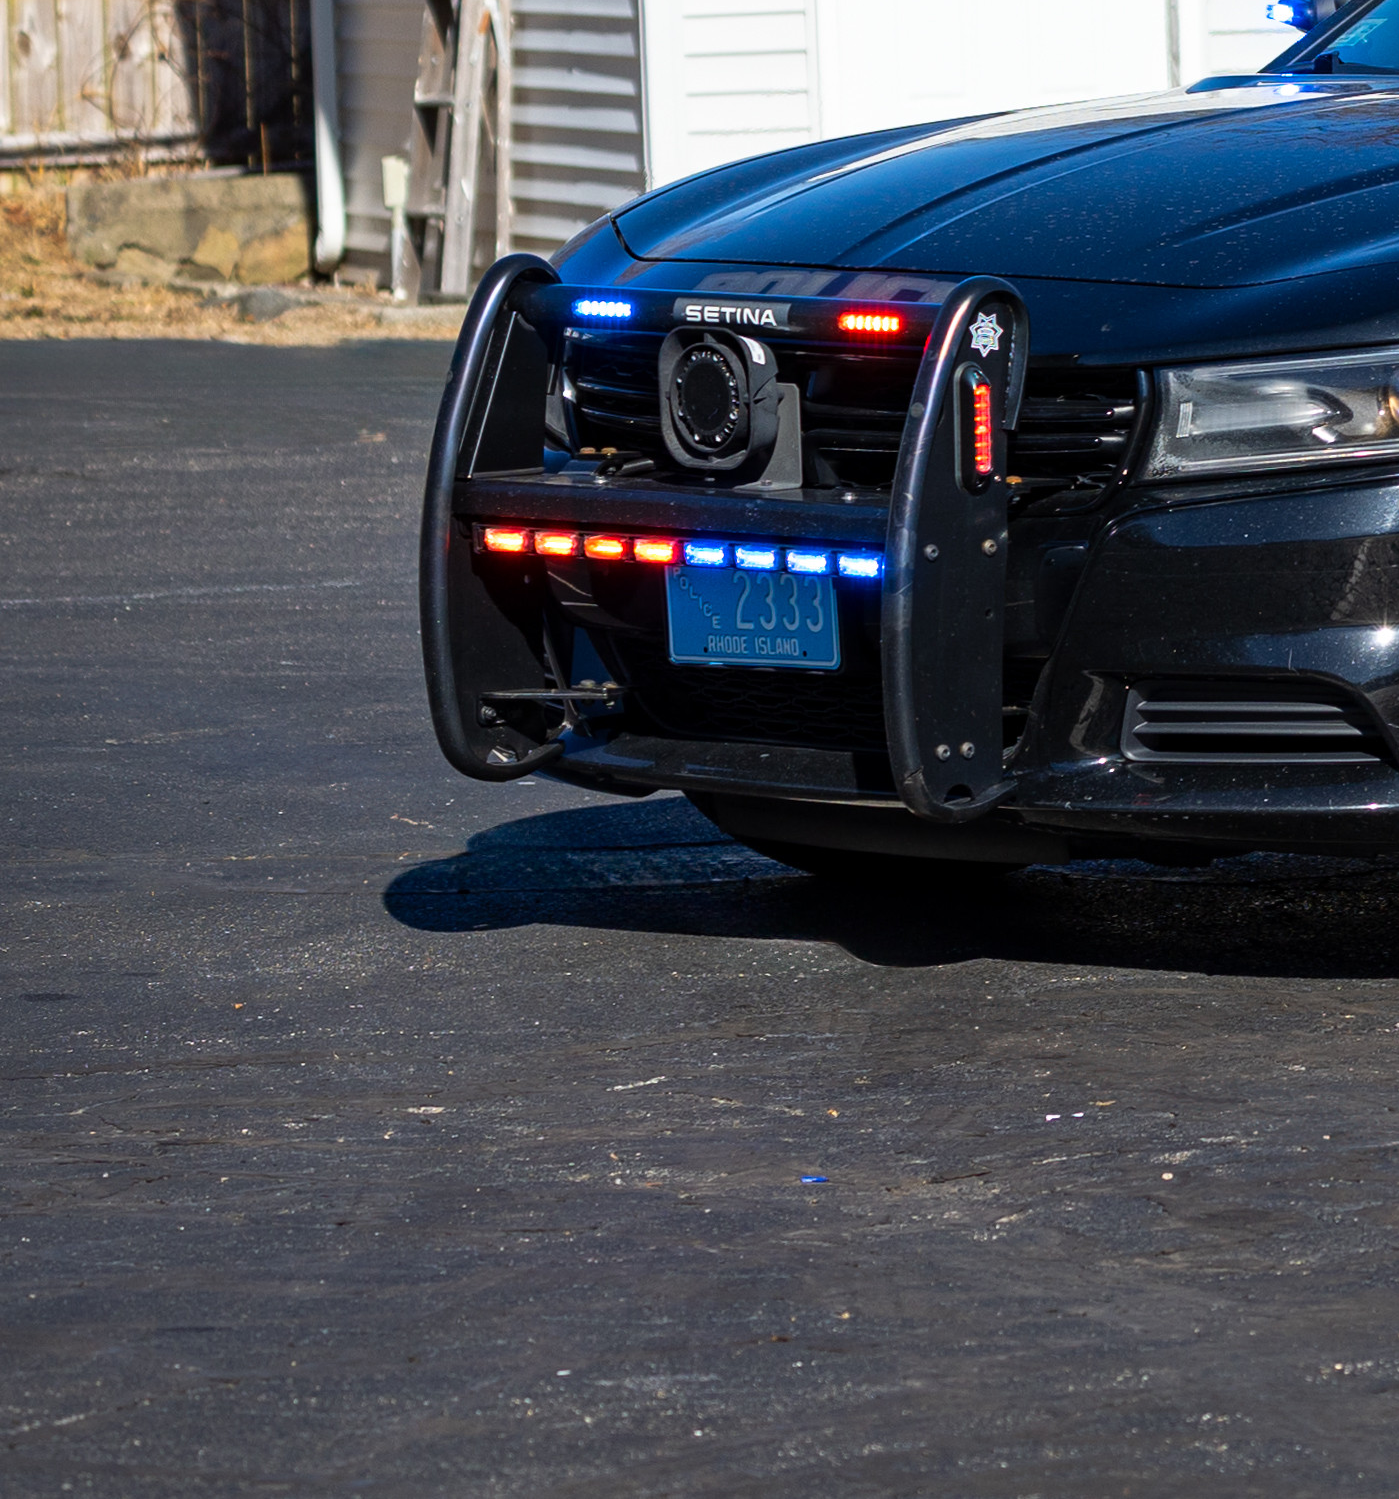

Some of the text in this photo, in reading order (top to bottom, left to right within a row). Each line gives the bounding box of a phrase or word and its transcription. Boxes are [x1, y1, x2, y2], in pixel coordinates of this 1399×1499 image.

[685, 305, 778, 327] SETINA
[672, 567, 824, 633] POLICE 2333
[708, 635, 800, 657] RHODE ISLAND
